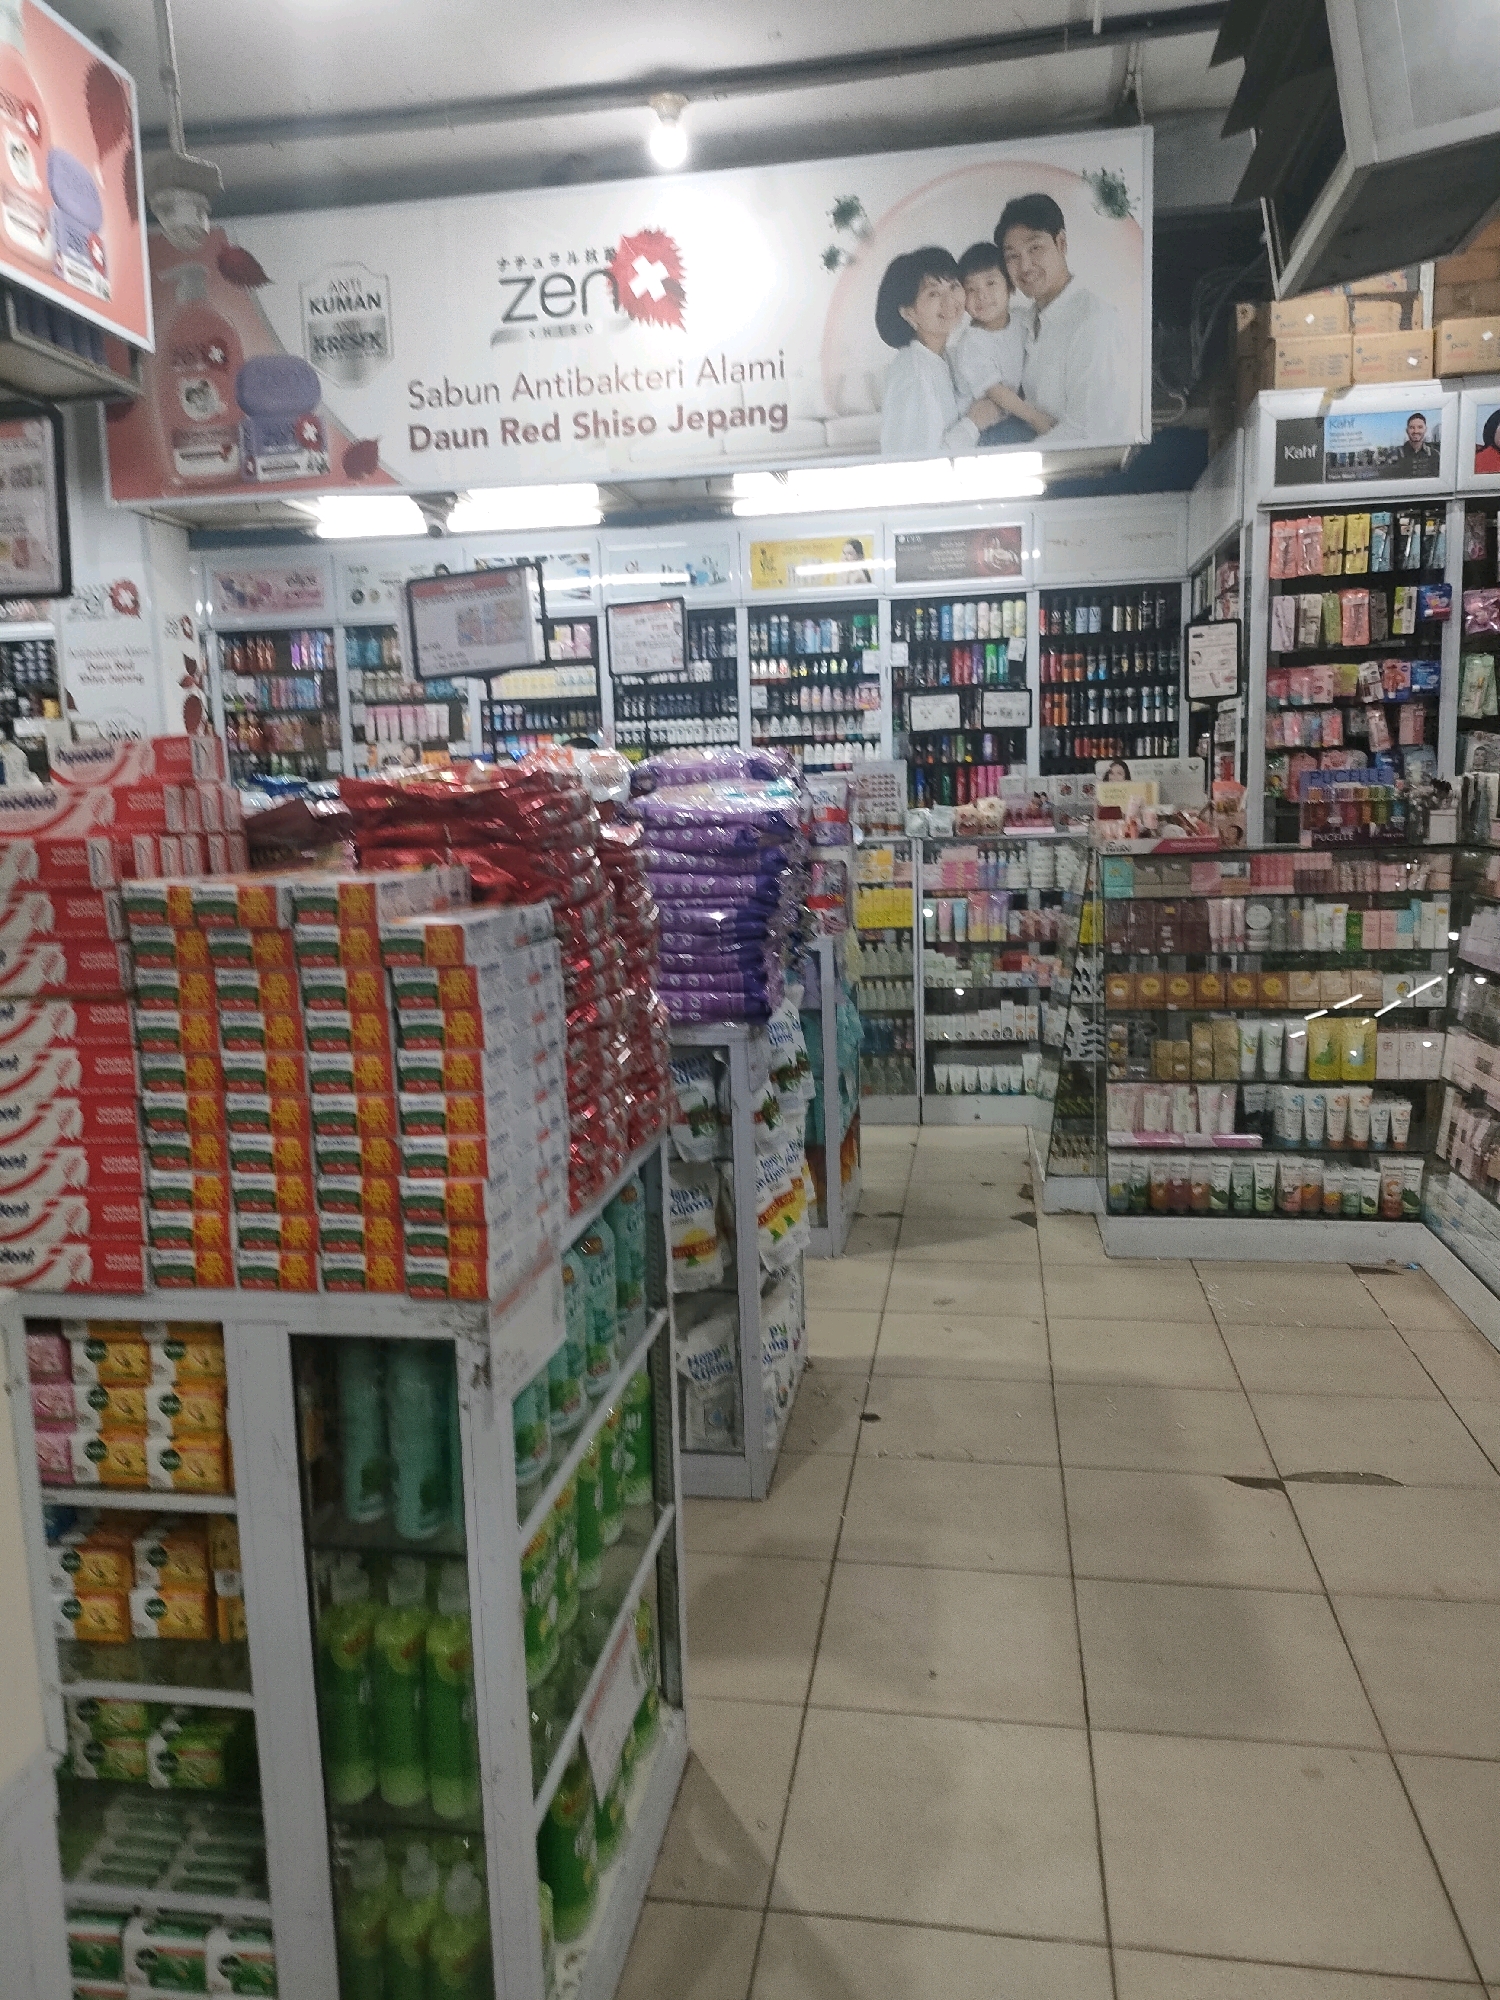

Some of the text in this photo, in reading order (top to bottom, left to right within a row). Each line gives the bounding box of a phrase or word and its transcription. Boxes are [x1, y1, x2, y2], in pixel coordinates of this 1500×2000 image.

[308, 292, 381, 315] KUMAN
[499, 270, 620, 324] zen
[407, 349, 786, 411] Sabun Antibakteri Alami
[408, 401, 788, 452] Daun Red Shiso Jepang
[1284, 444, 1318, 460] Kahf
[1310, 768, 1386, 784] PUCELLE
[1313, 833, 1354, 842] PUCELLE
